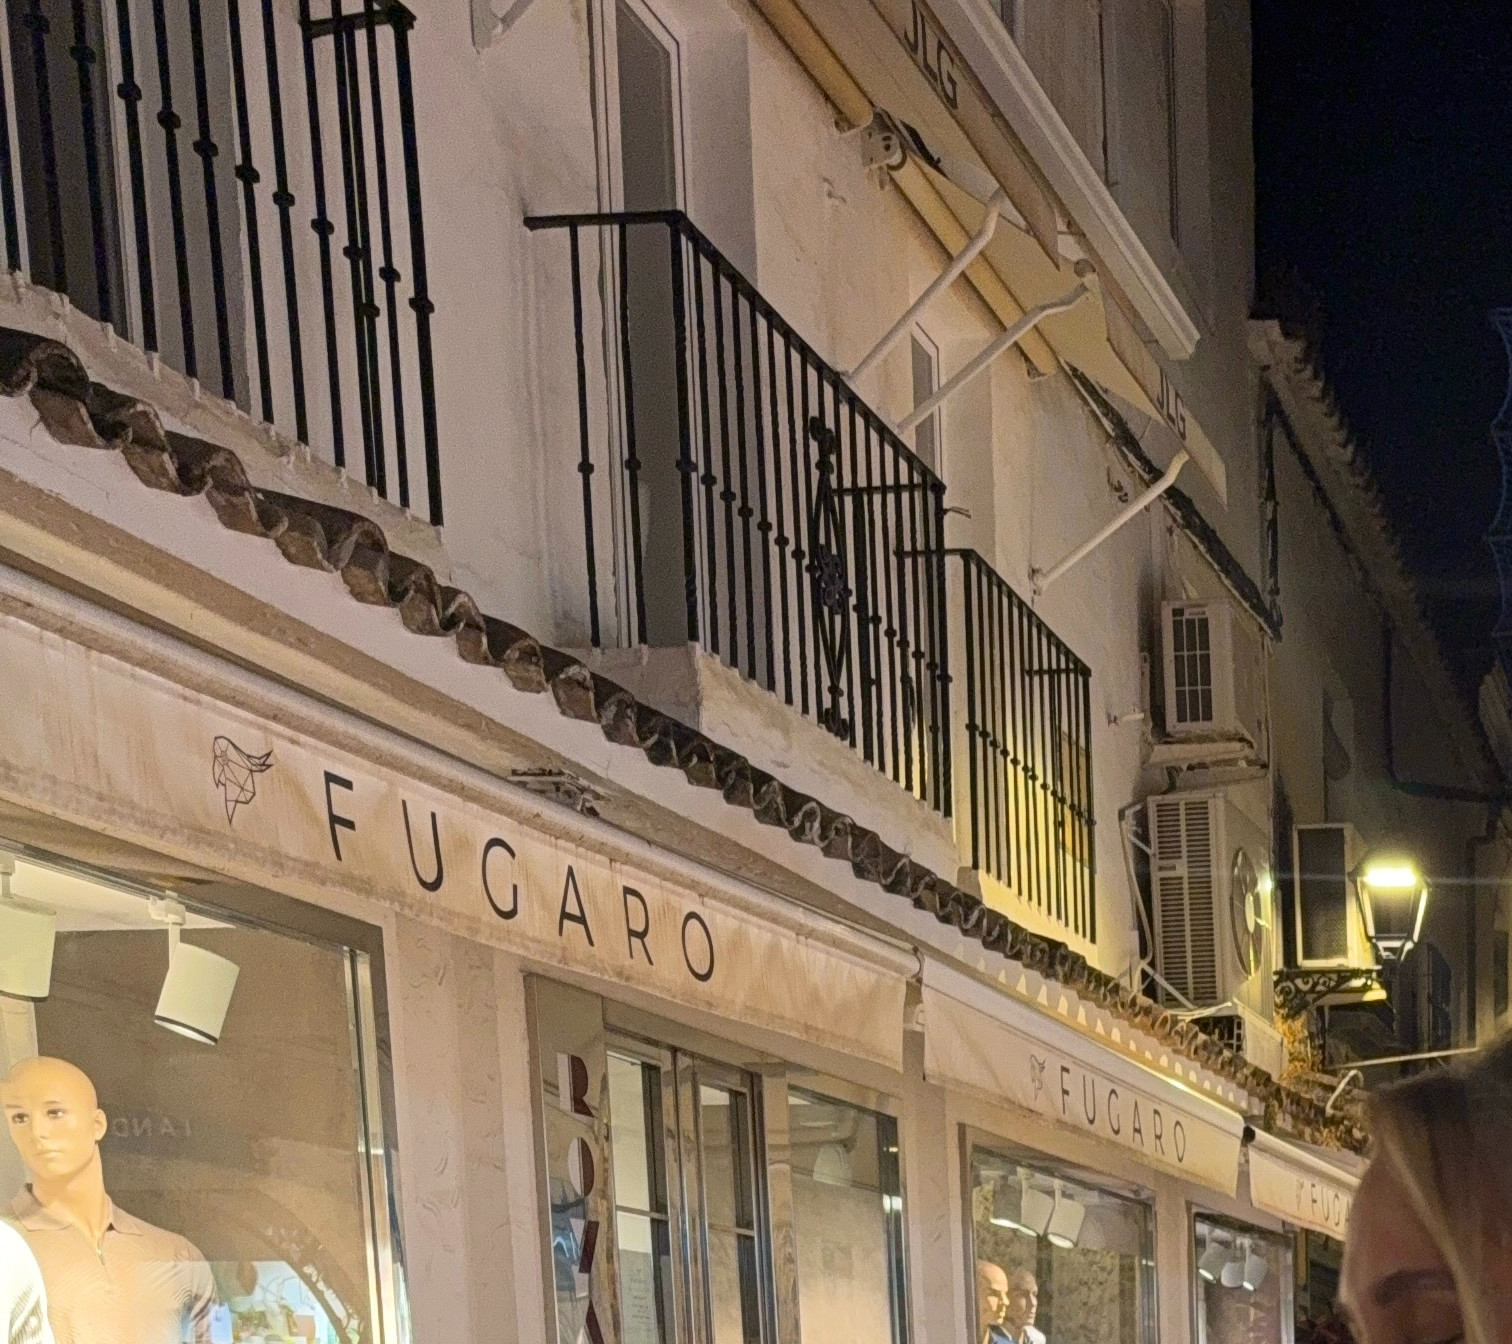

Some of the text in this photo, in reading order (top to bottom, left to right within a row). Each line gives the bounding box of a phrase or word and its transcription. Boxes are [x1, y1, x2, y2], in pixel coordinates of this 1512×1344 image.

[1156, 366, 1187, 441] JLG
[323, 769, 716, 983] FUGARO
[1060, 1064, 1187, 1164] FUGARO
